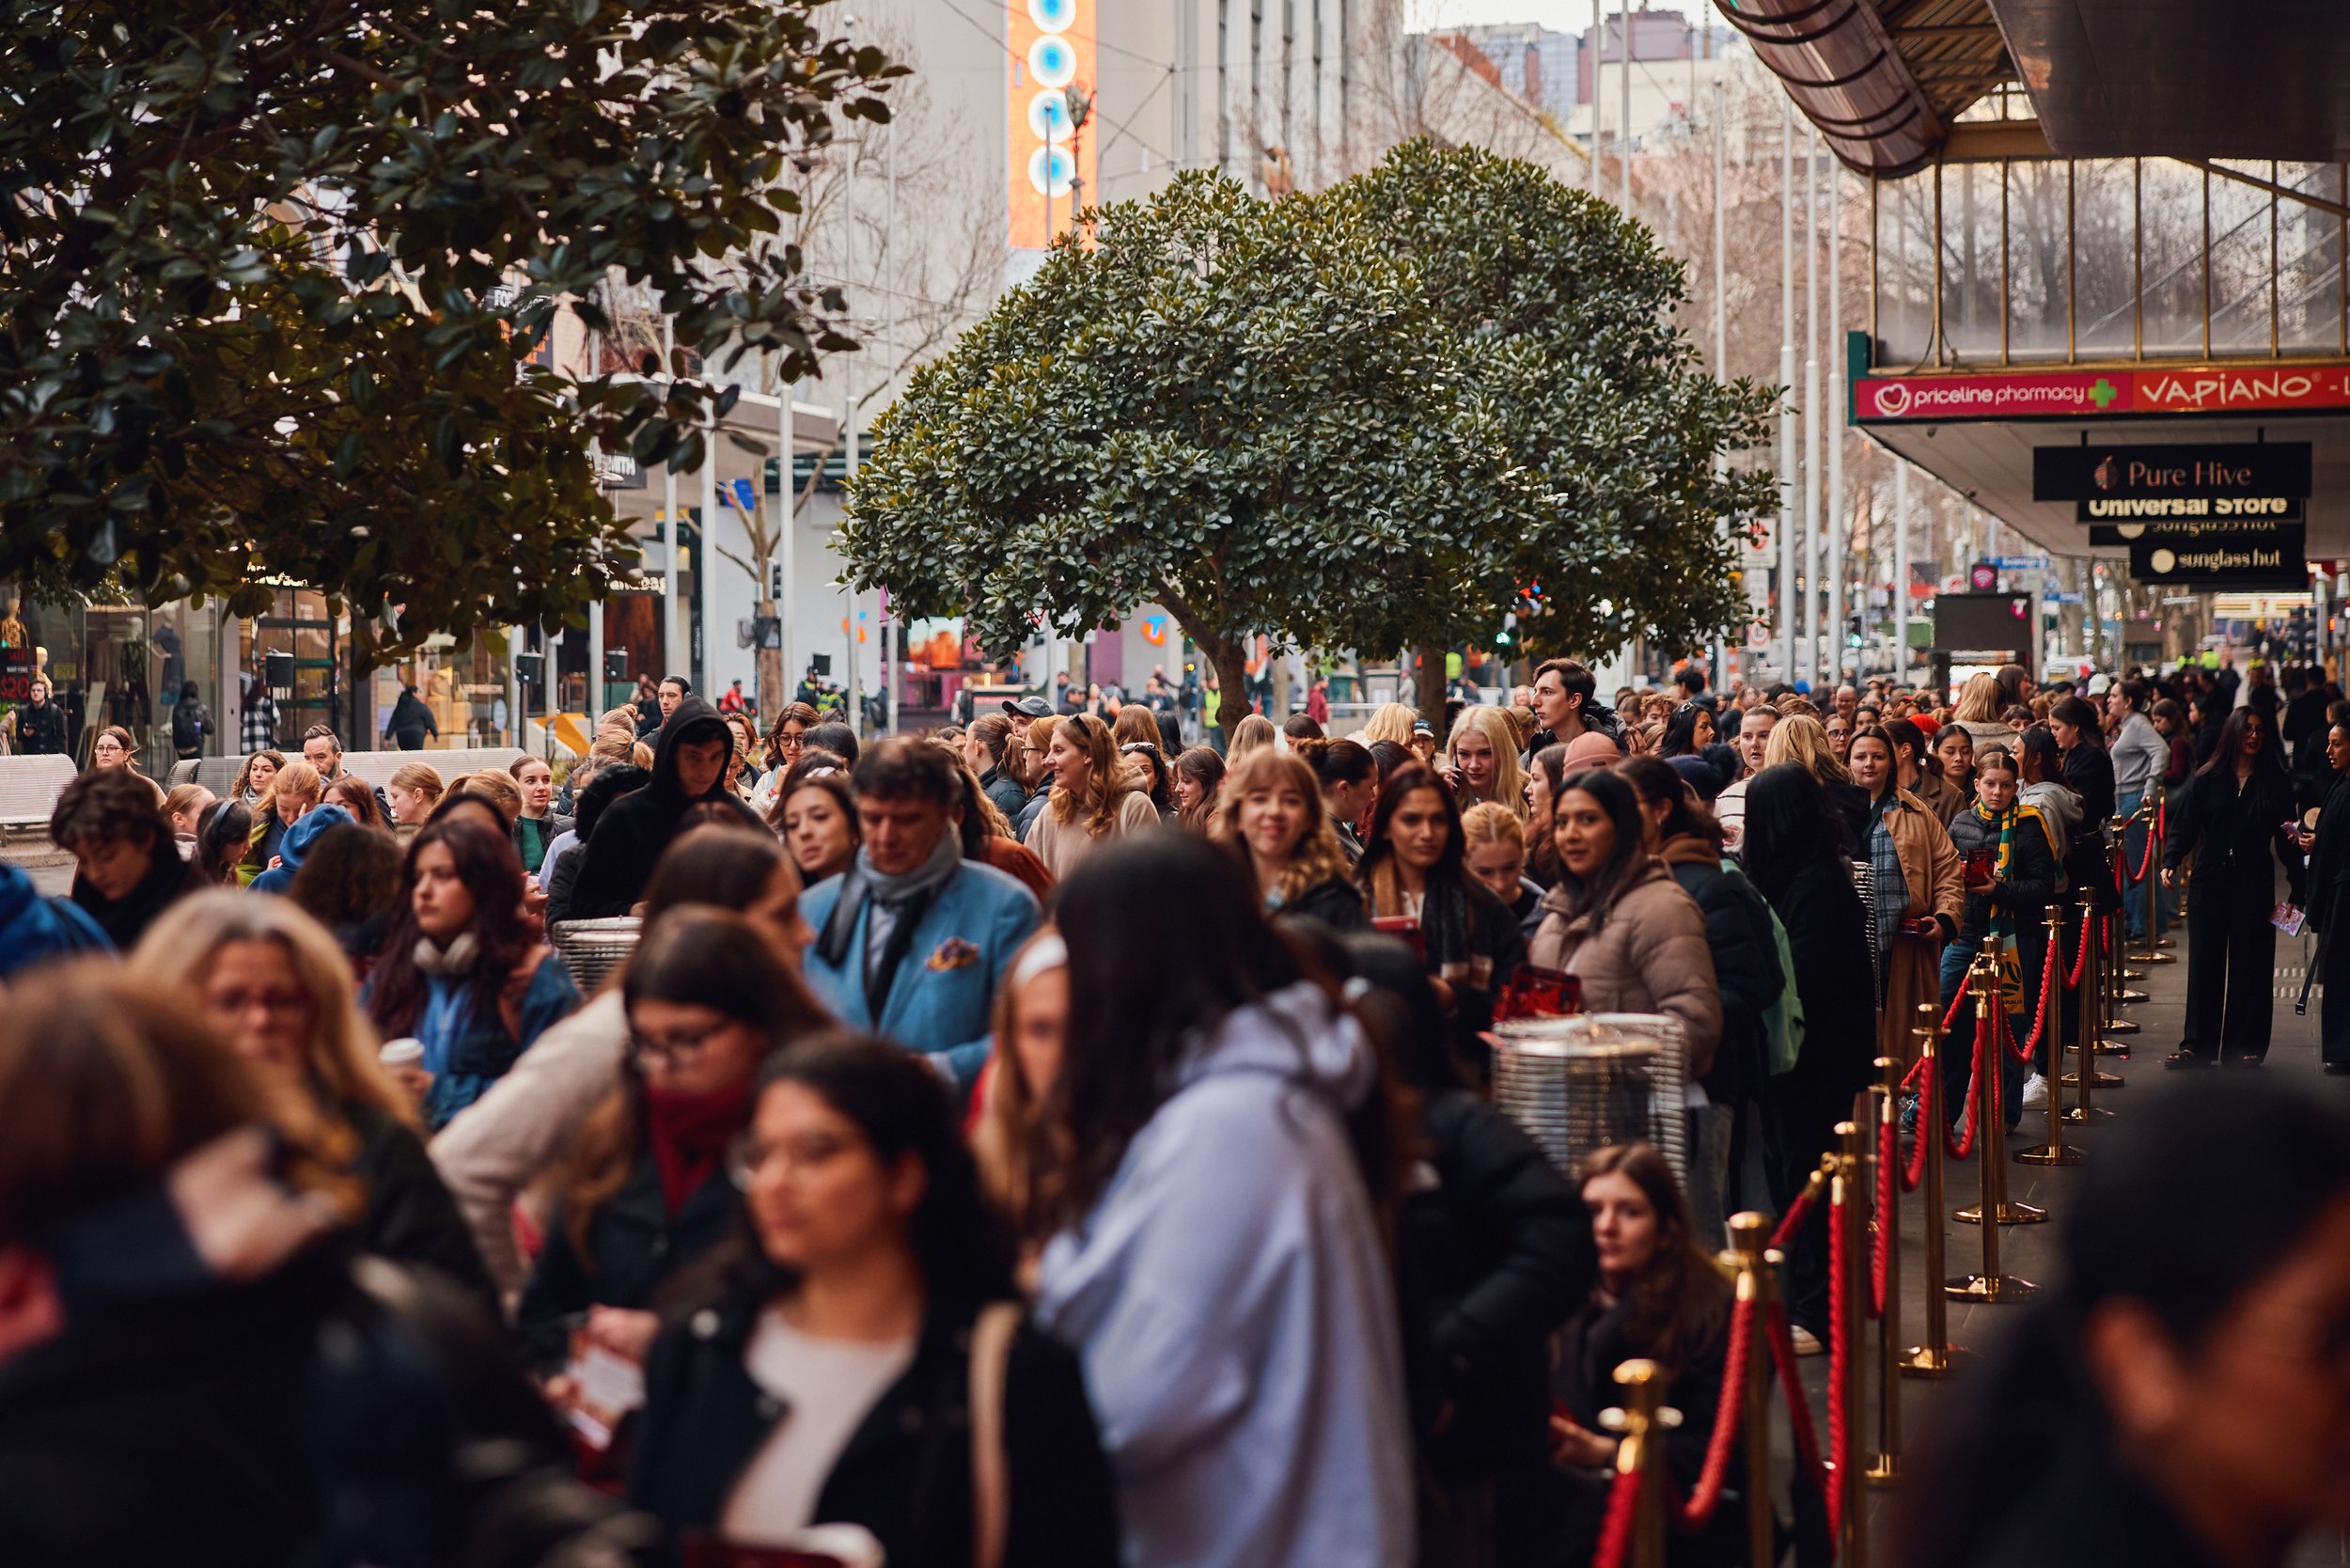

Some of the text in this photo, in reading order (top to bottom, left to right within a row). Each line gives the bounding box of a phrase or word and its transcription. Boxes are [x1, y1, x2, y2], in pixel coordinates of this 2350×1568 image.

[1914, 384, 2085, 409] priceline pharmacy
[2129, 461, 2251, 487] Pure Hive
[2088, 497, 2288, 516] Universal Store
[2178, 547, 2281, 572] sunglass hut
